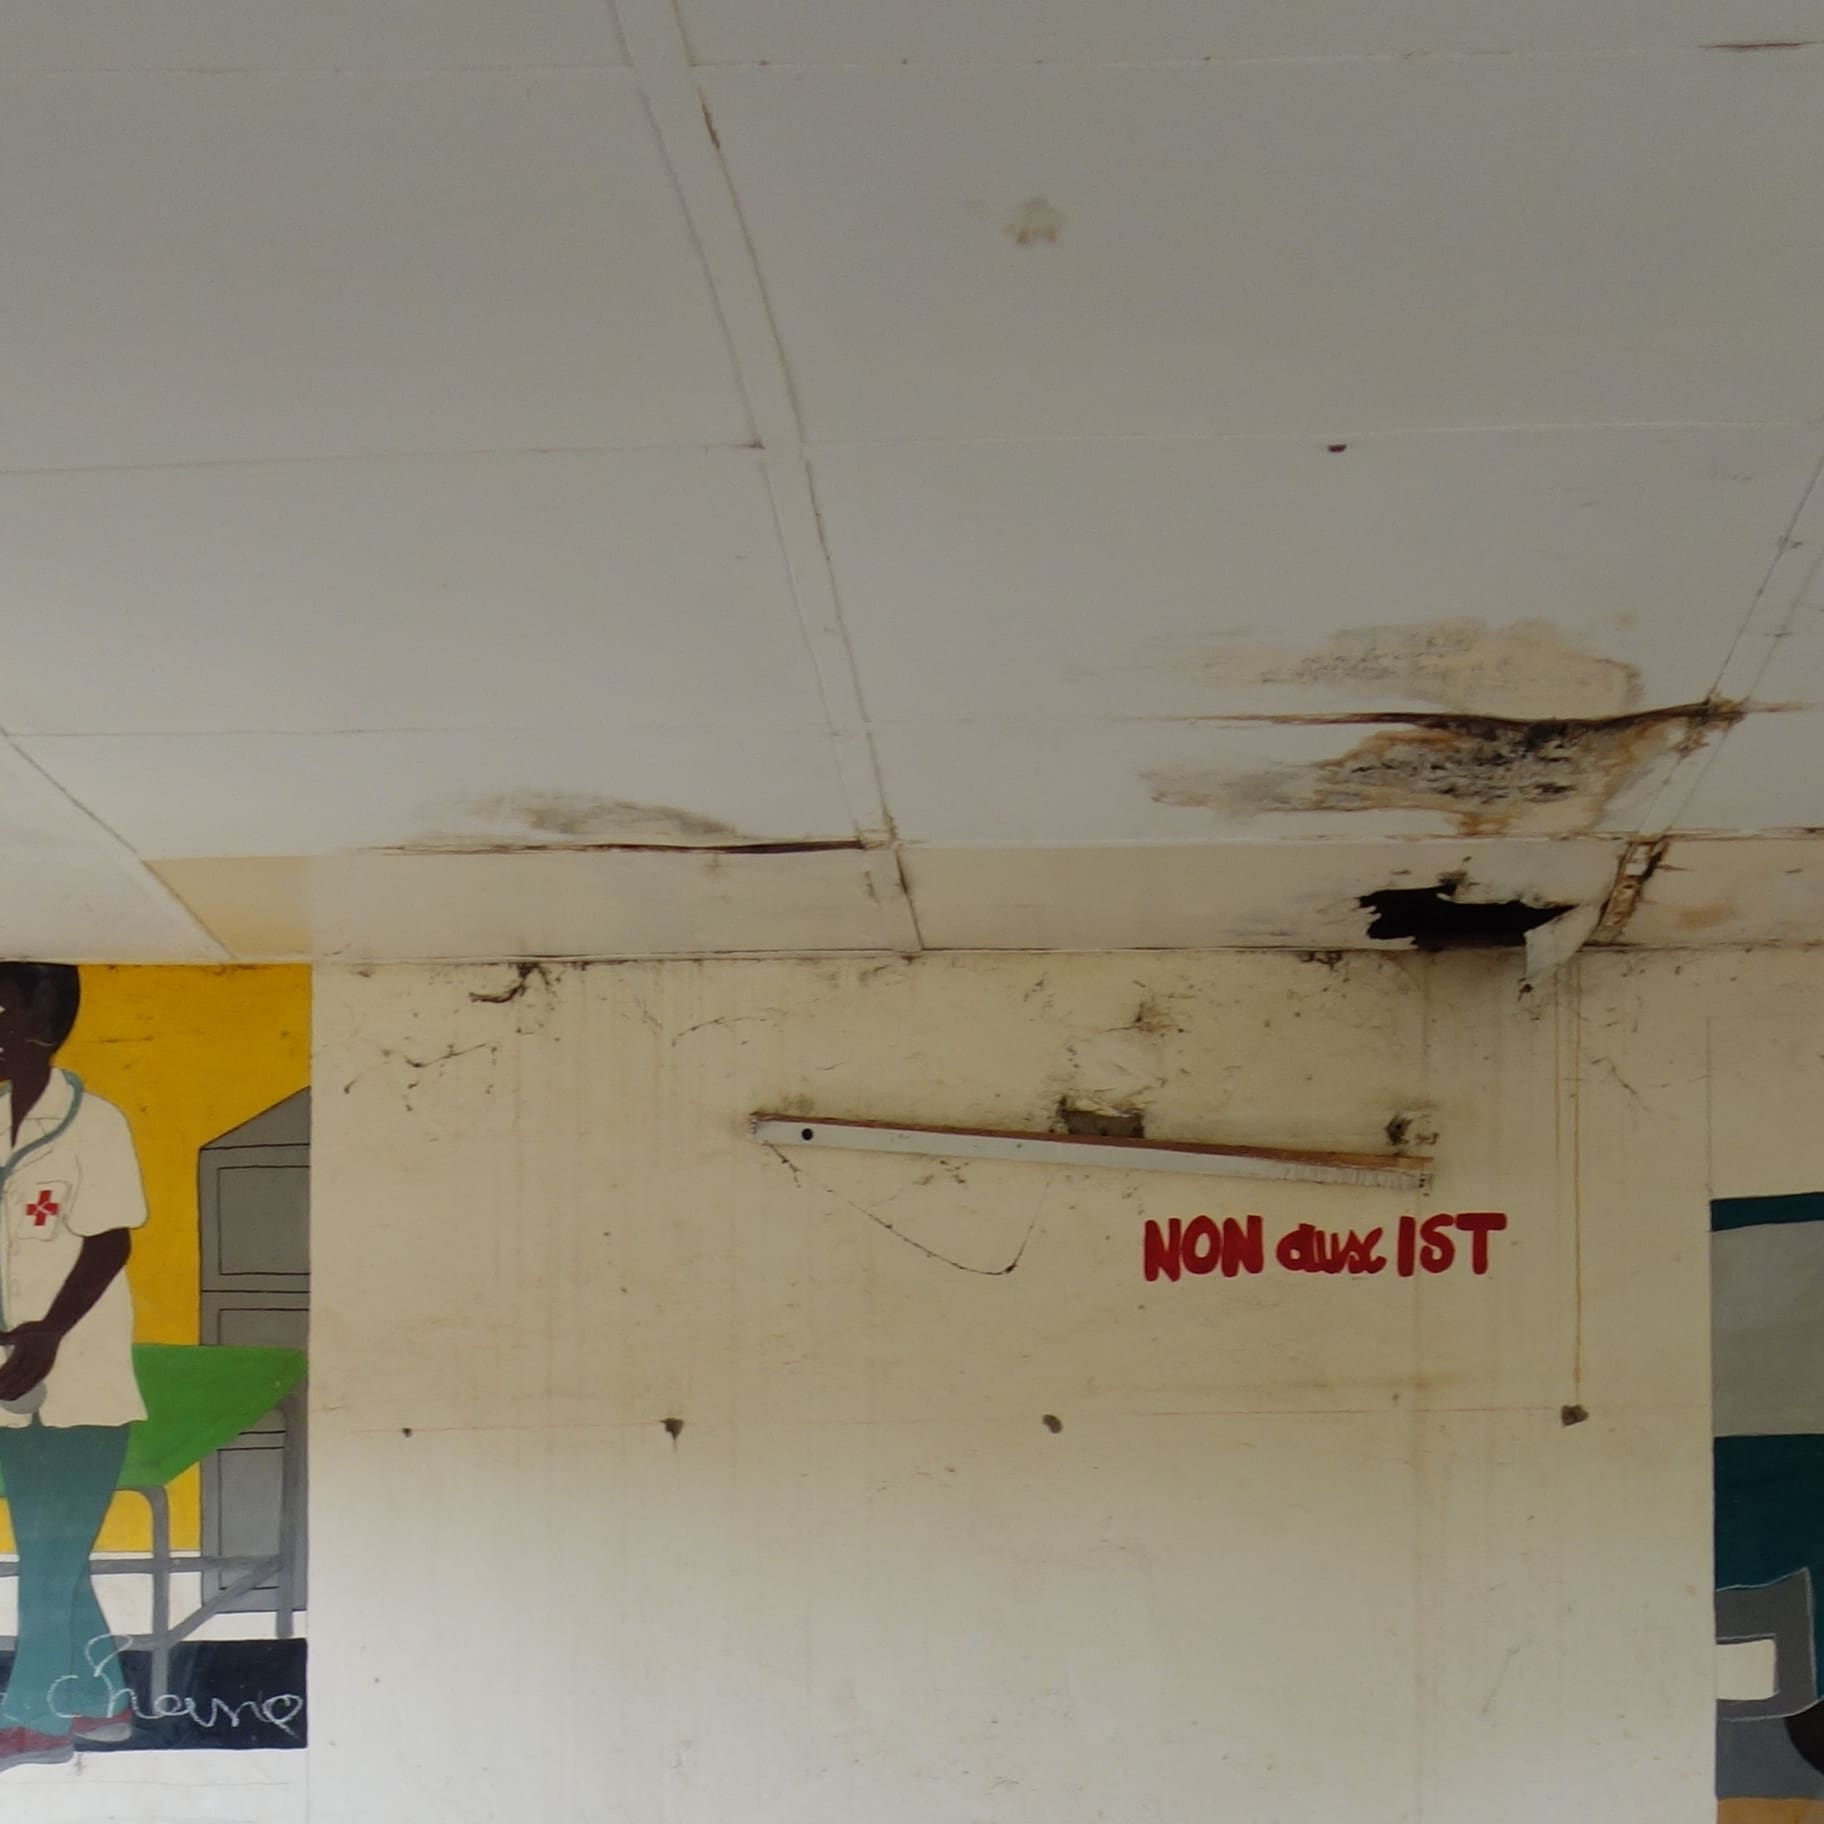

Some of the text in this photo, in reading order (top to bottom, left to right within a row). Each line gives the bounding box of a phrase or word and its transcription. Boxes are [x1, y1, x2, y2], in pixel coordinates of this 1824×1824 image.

[1144, 1212, 1508, 1282] NON aux IST
